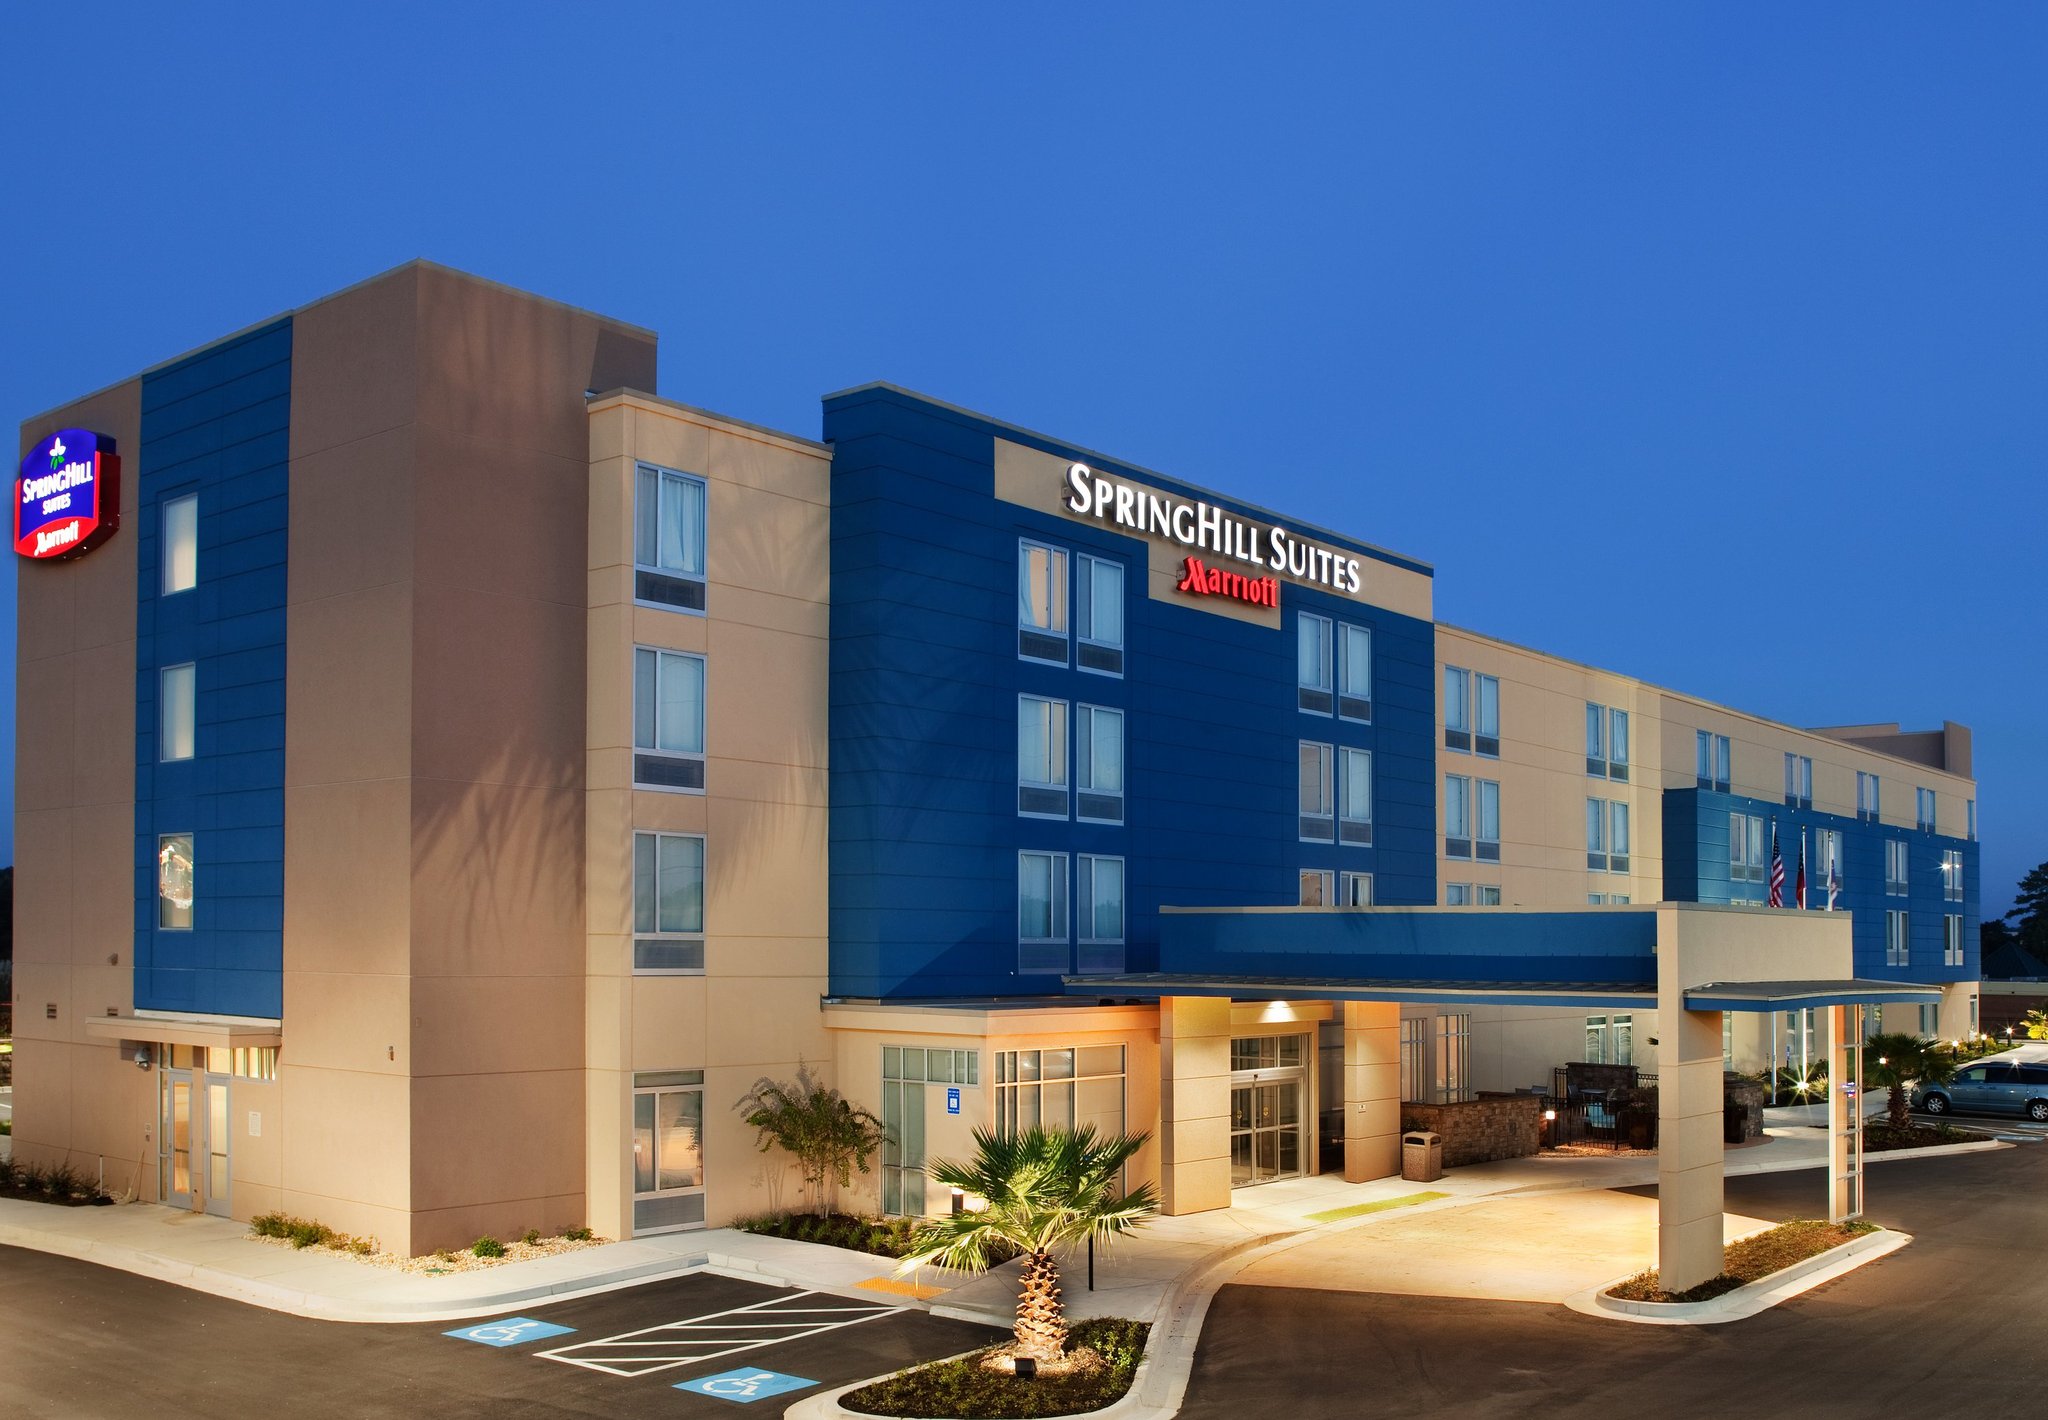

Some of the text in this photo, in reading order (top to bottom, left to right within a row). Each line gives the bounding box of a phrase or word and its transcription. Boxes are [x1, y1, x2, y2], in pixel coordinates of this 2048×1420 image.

[23, 461, 93, 503] SPRINGHILL
[42, 493, 71, 515] SUITES
[34, 520, 79, 556] Marriott
[1067, 462, 1361, 594] SPRINGHILL SUITES
[1177, 555, 1278, 608] Marriott
